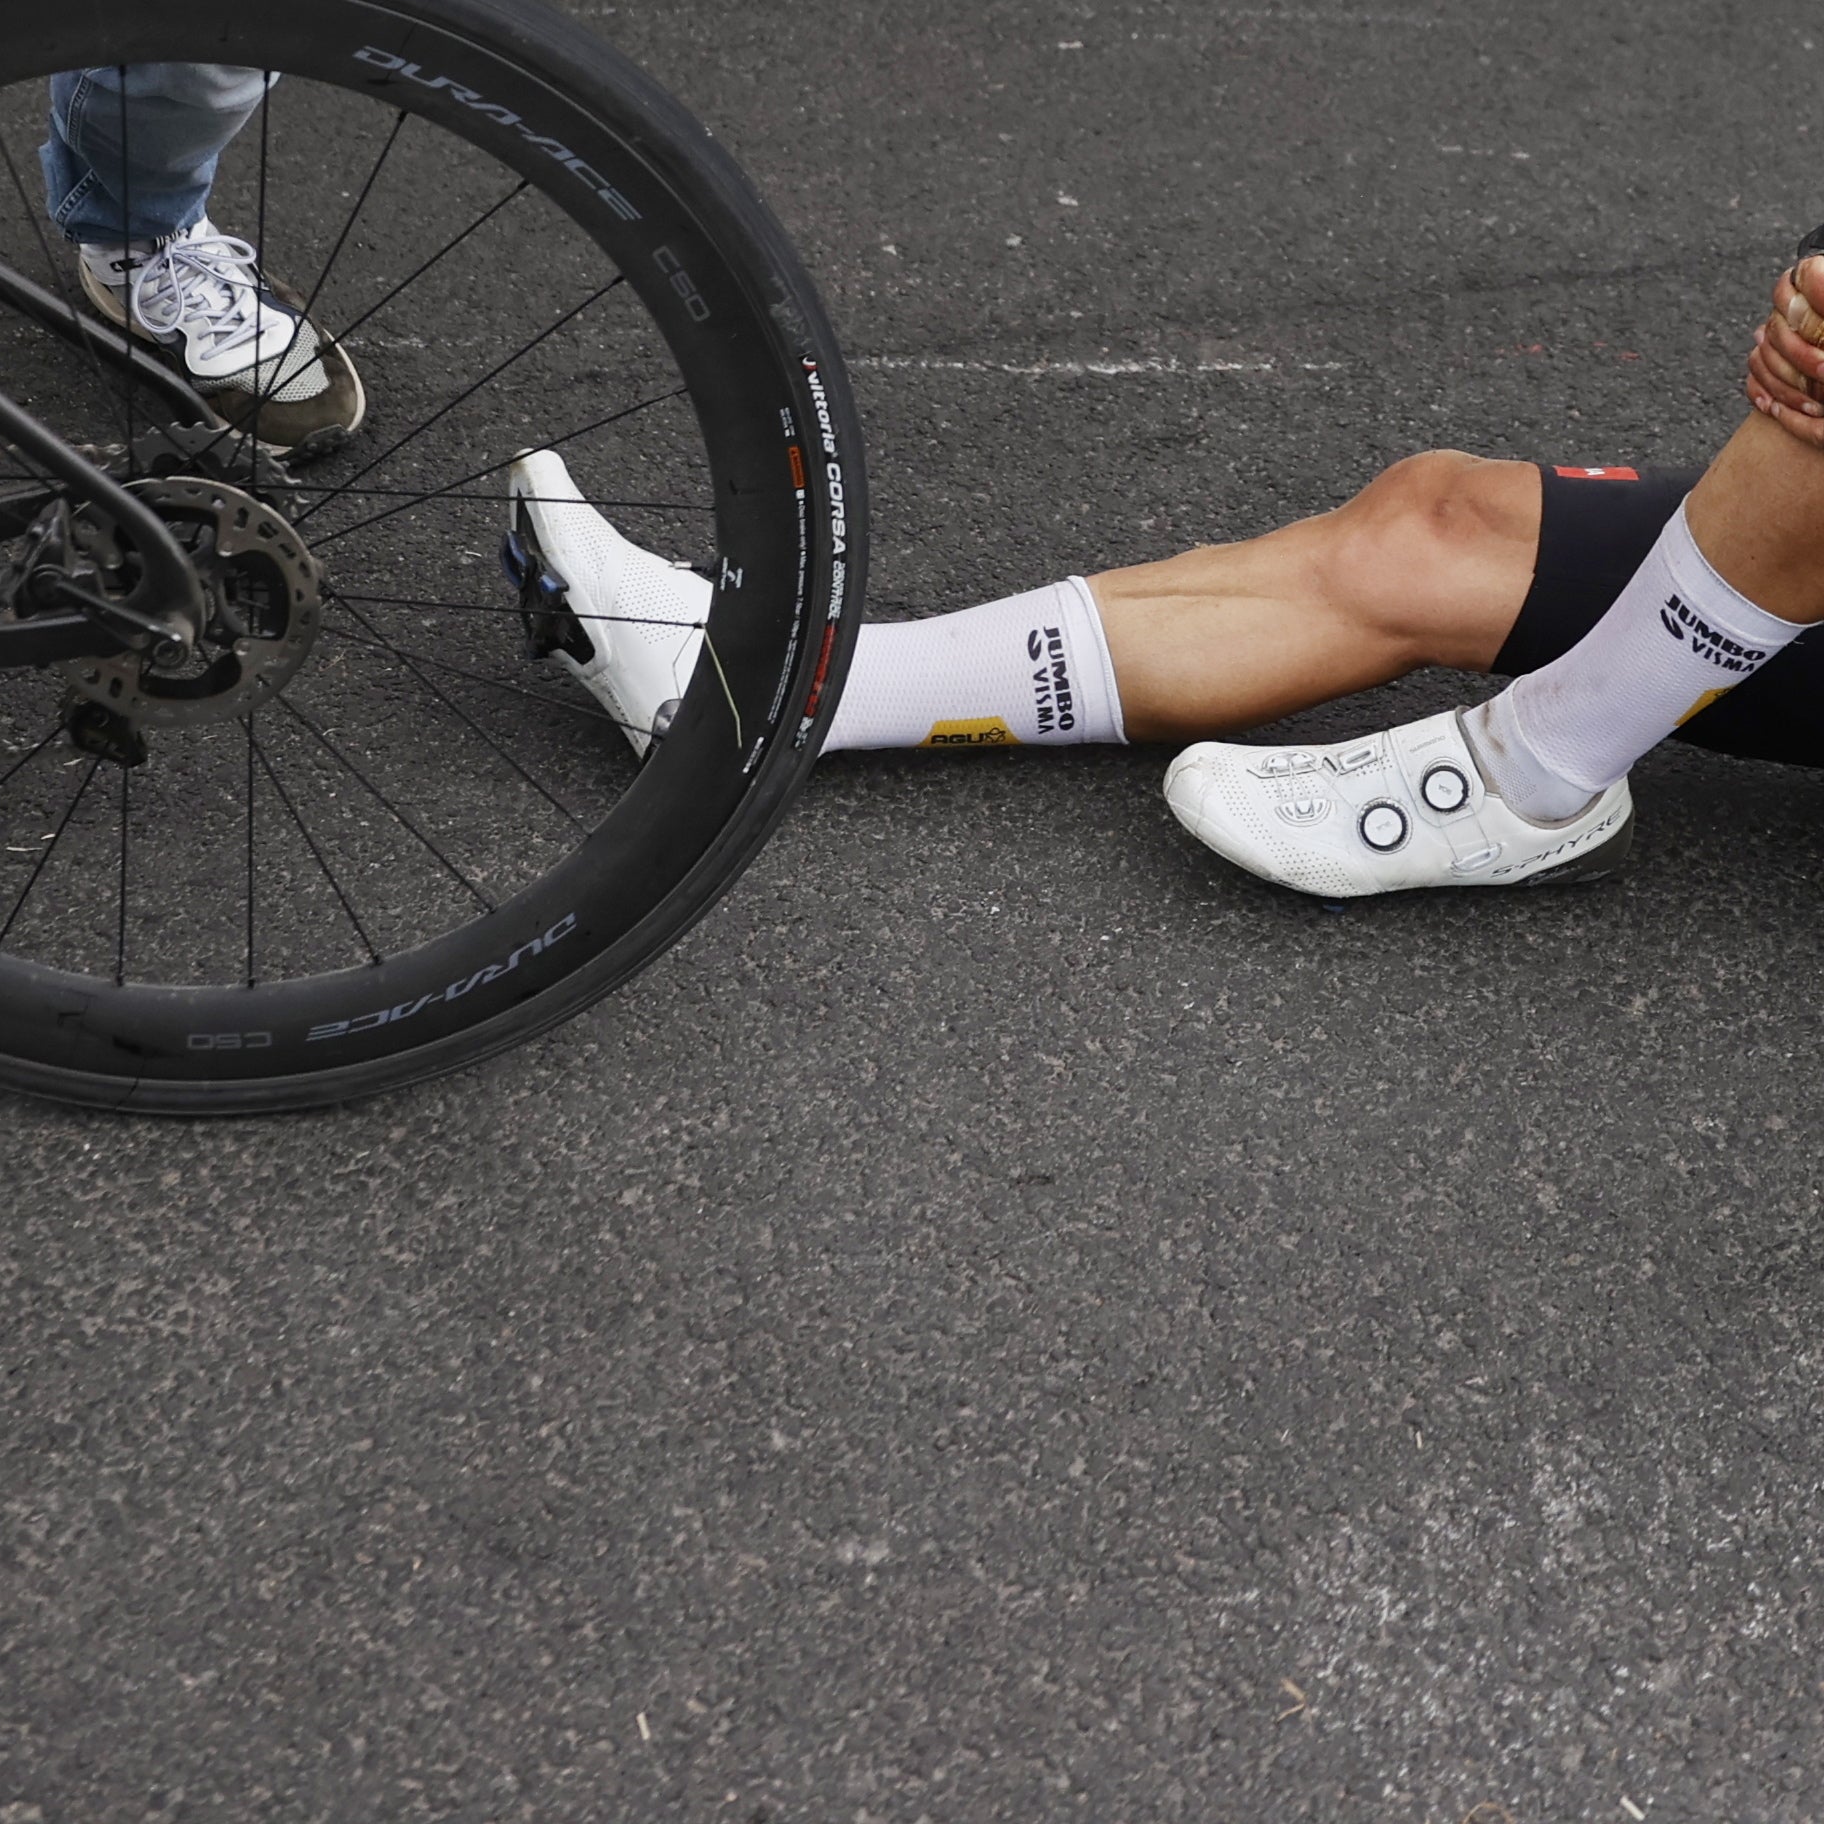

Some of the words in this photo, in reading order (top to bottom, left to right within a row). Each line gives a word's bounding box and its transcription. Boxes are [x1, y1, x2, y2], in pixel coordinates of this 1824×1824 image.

[351, 44, 643, 222] DURA-ACE
[651, 244, 711, 323] C50
[807, 370, 837, 456] vittoria
[826, 462, 847, 555] CORSA
[1663, 592, 1766, 661] JUMBO
[1690, 637, 1765, 676] VISMA
[1032, 669, 1054, 735] VISMA
[1042, 625, 1077, 732] JUMBO
[930, 731, 985, 746] AGU
[1491, 804, 1623, 879] S-PHYRE
[304, 911, 577, 1043] DURA-ACE
